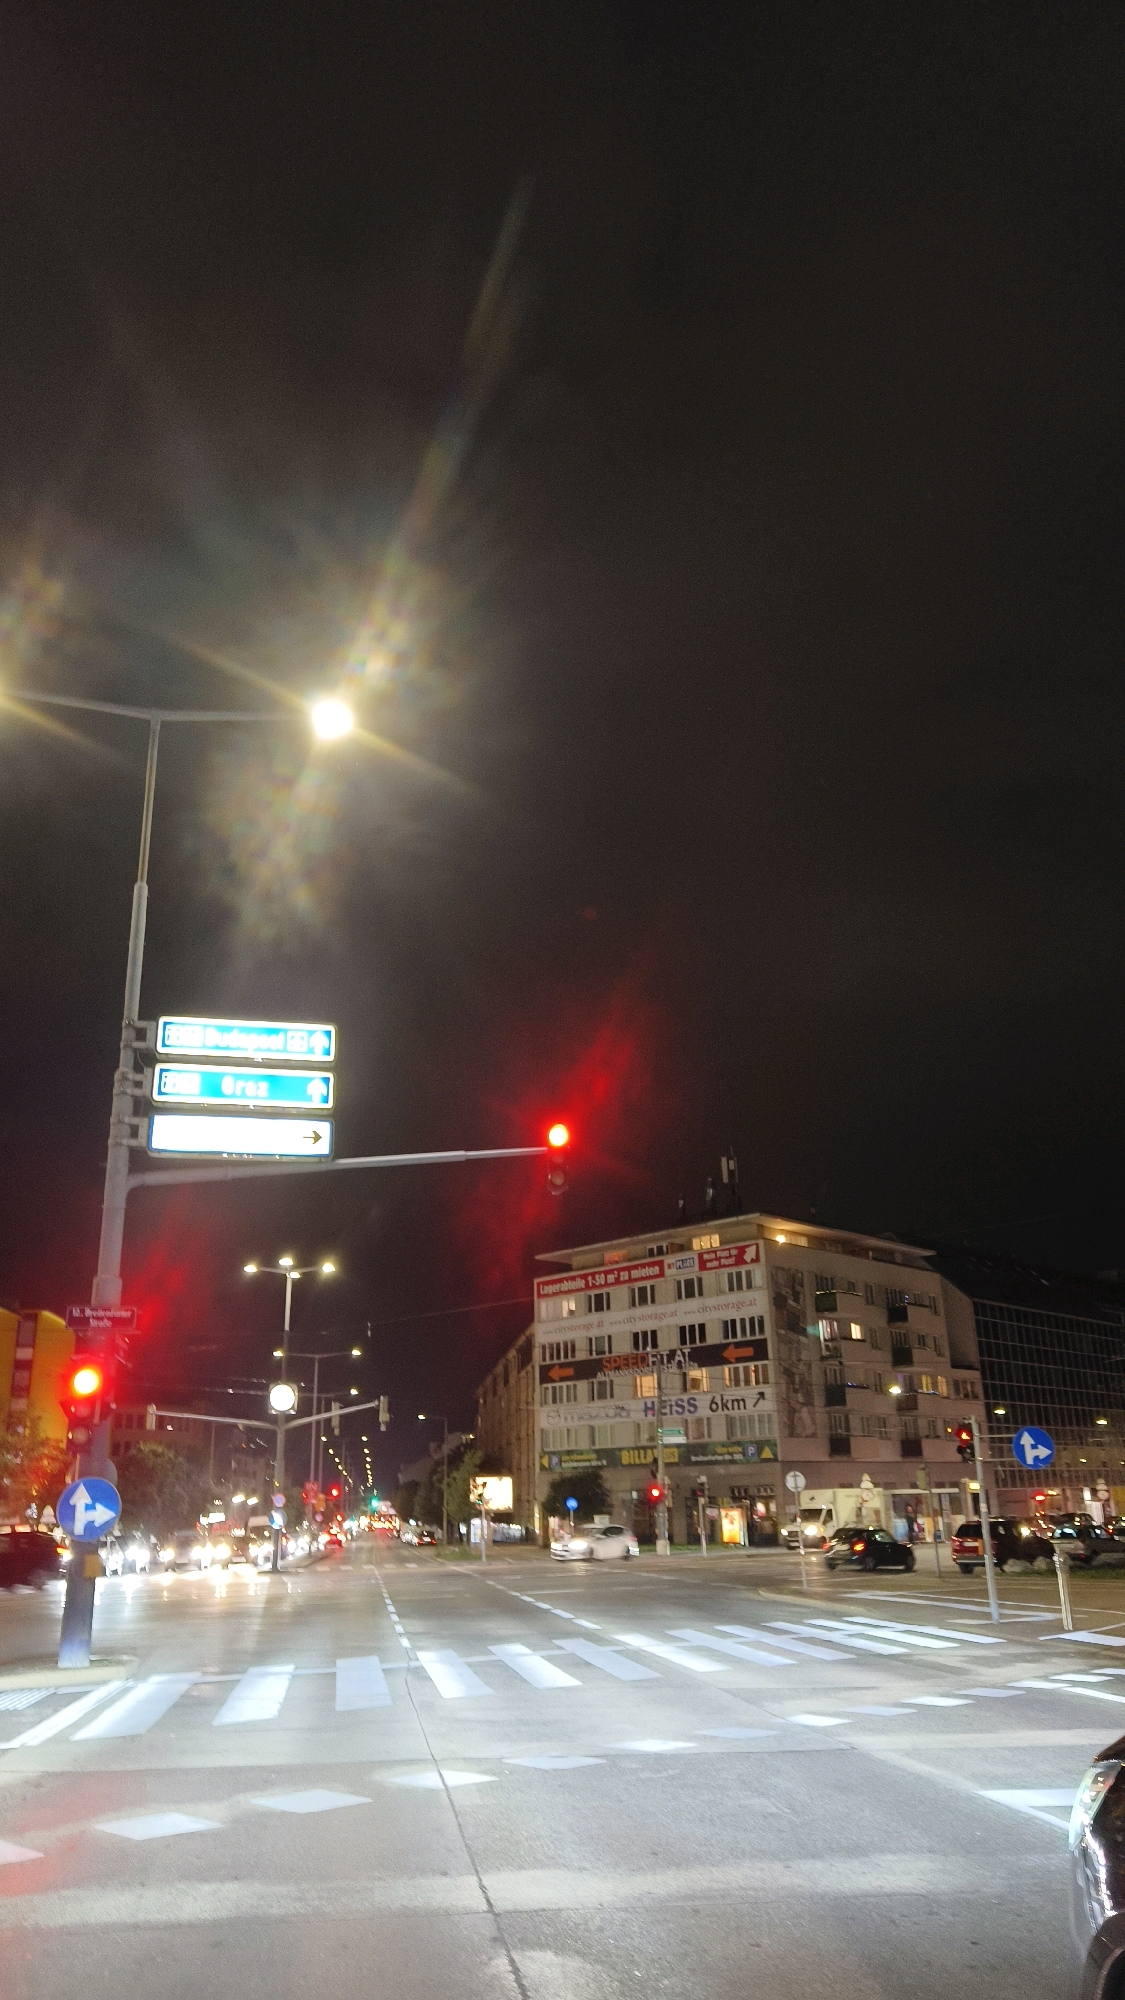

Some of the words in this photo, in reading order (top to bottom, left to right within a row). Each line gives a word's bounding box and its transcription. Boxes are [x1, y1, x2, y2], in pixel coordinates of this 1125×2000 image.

[540, 1277, 585, 1295] Lagerabteile
[587, 1273, 605, 1287] 1-50
[620, 1270, 629, 1281] zu
[631, 1265, 660, 1279] mieten
[709, 1394, 747, 1413] 6km
[621, 1448, 655, 1465] BILLA
